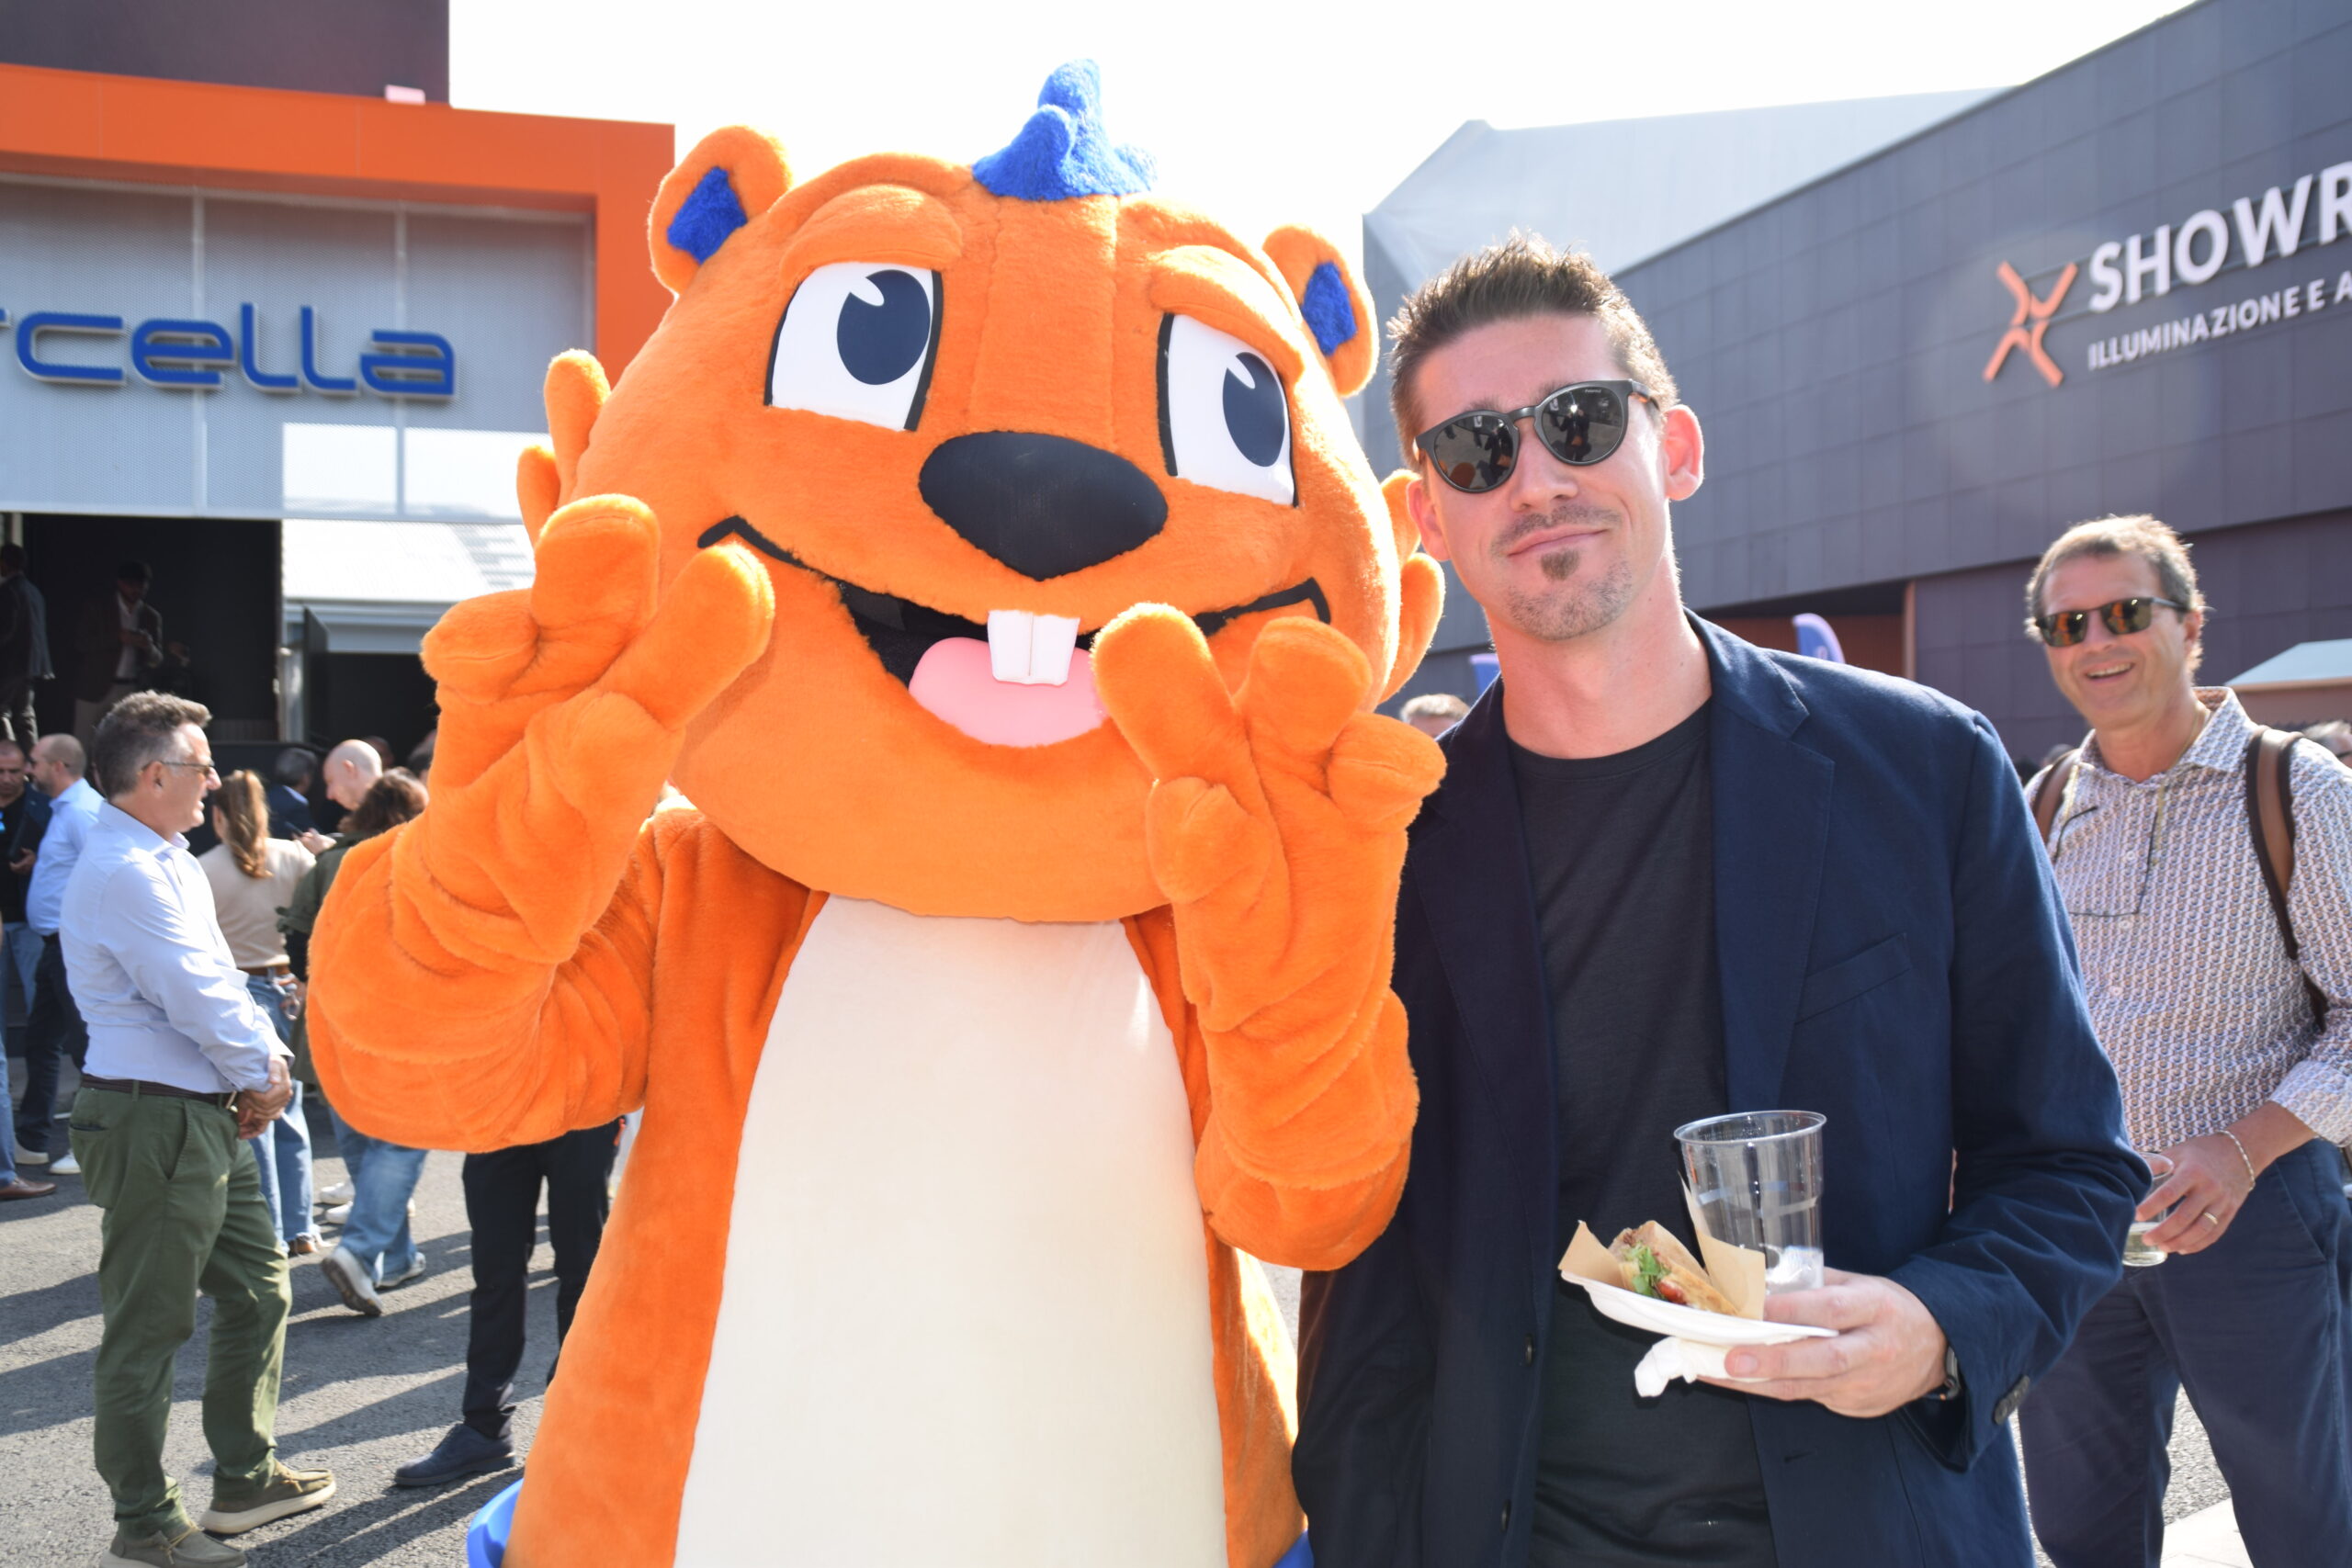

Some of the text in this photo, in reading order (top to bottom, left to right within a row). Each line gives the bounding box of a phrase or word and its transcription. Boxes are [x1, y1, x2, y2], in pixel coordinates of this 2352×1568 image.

[2088, 161, 2352, 312] SHOWR
[0, 302, 456, 397] cella
[2088, 286, 2301, 369] ILLUMINAZIONE
[2307, 278, 2326, 311] E
